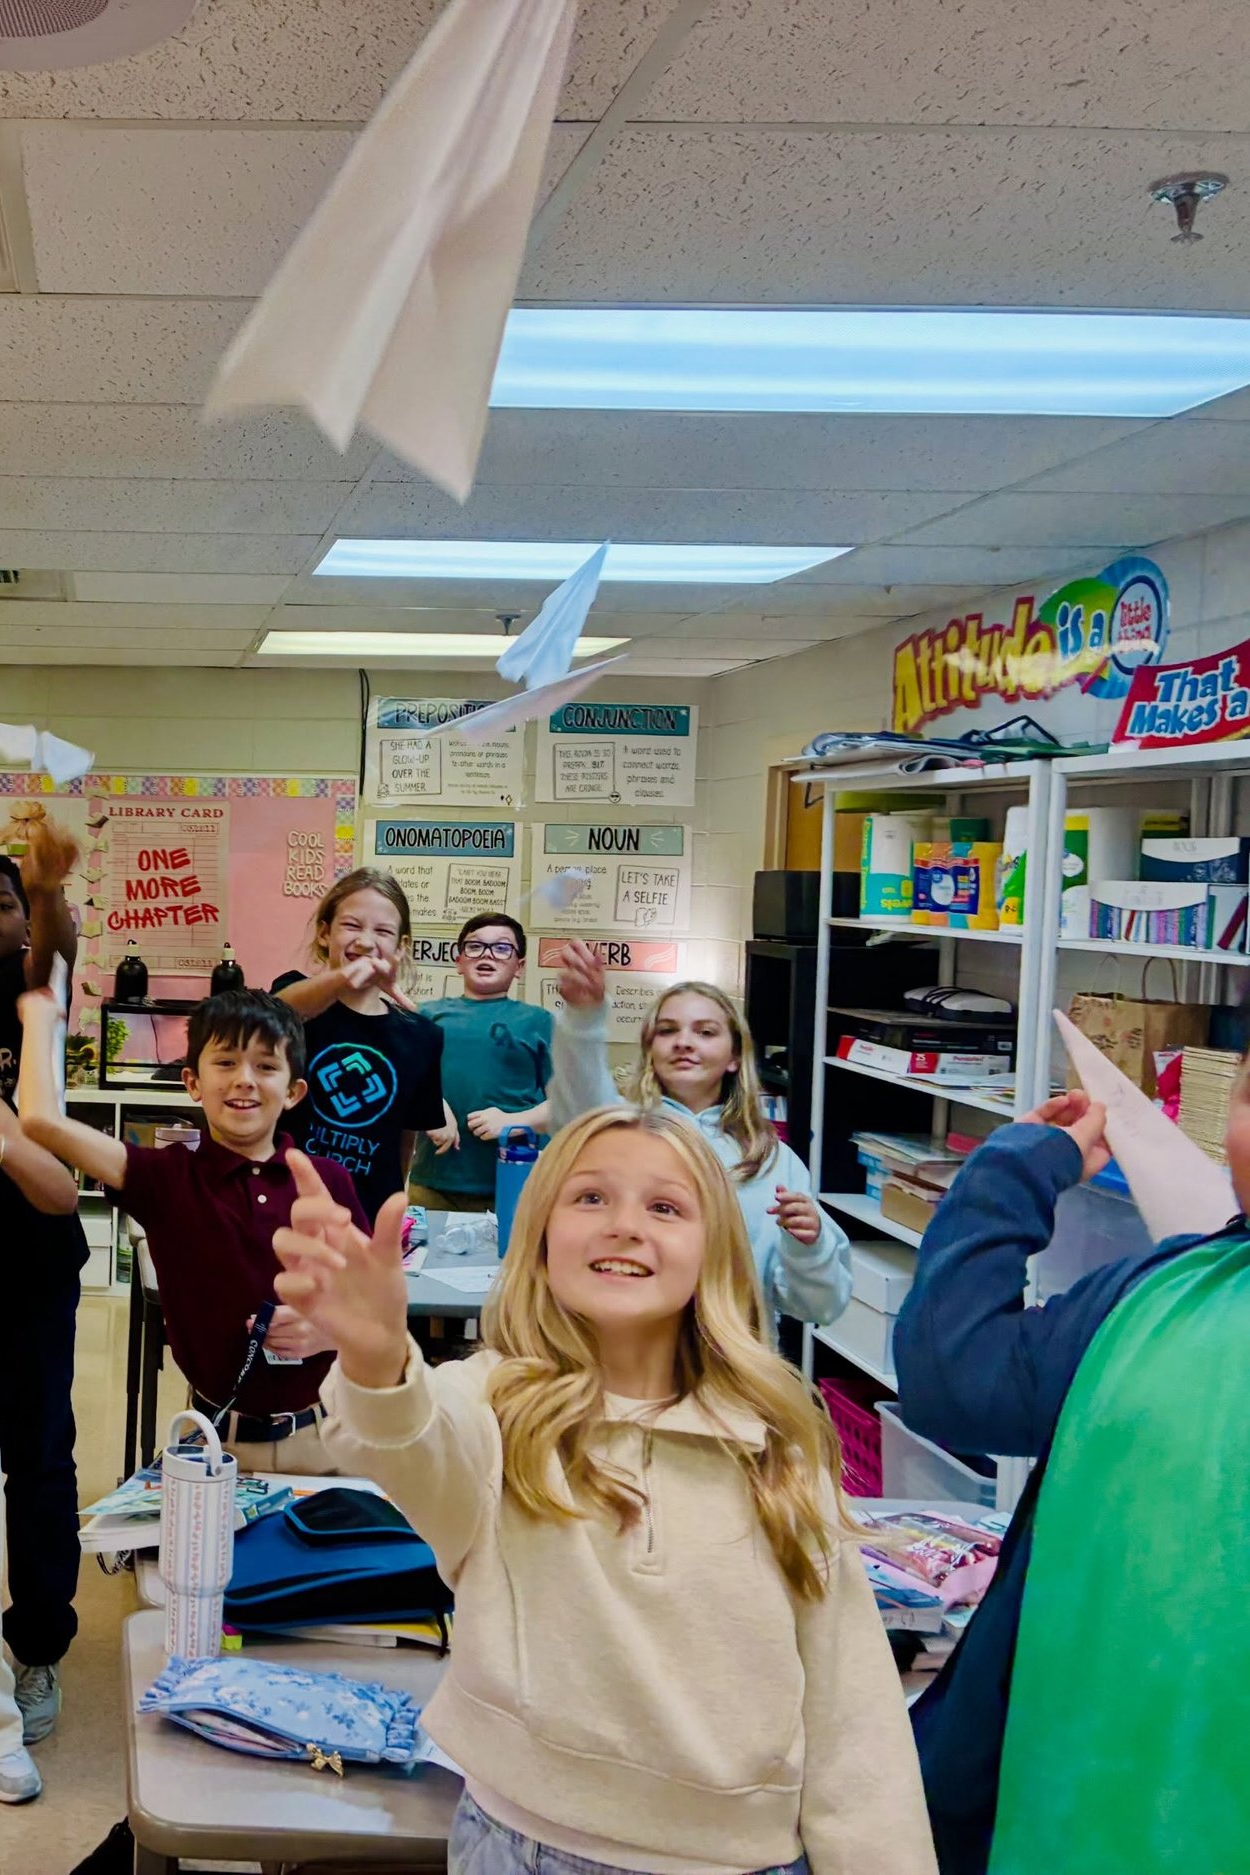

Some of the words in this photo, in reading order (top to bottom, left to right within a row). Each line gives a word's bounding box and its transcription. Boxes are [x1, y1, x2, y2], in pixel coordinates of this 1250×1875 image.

[1120, 597, 1151, 628] little
[894, 597, 1055, 733] Attitude
[1057, 601, 1084, 660] is
[1089, 610, 1106, 649] a
[1153, 654, 1238, 703] That
[563, 705, 676, 731] CONJUNCTION
[1129, 698, 1218, 739] Makes
[1228, 688, 1249, 721] a
[390, 741, 405, 751] SHE
[407, 741, 423, 750] HAD
[426, 741, 431, 749] A
[393, 755, 430, 765] GLOW-UP
[392, 769, 413, 779] OVER
[416, 768, 430, 778] THE
[109, 807, 175, 817] LIBRARY
[181, 808, 224, 818] CARD
[287, 830, 325, 848] COOL
[385, 827, 505, 849] ONOMATOPOEIA
[588, 827, 640, 851] NOUN
[137, 848, 190, 872] ONE
[288, 848, 326, 865] KIDS
[286, 865, 325, 882] READ
[395, 865, 415, 875] word
[418, 866, 433, 874] that
[126, 875, 202, 901] MORE
[621, 872, 649, 886] LET'S
[654, 874, 676, 887] TAKE
[283, 881, 329, 898] BOOKS
[417, 894, 429, 902] the
[623, 892, 630, 902] A
[634, 892, 669, 905] SELFIE
[107, 903, 219, 930] CHAPTER
[587, 942, 631, 967] VERB
